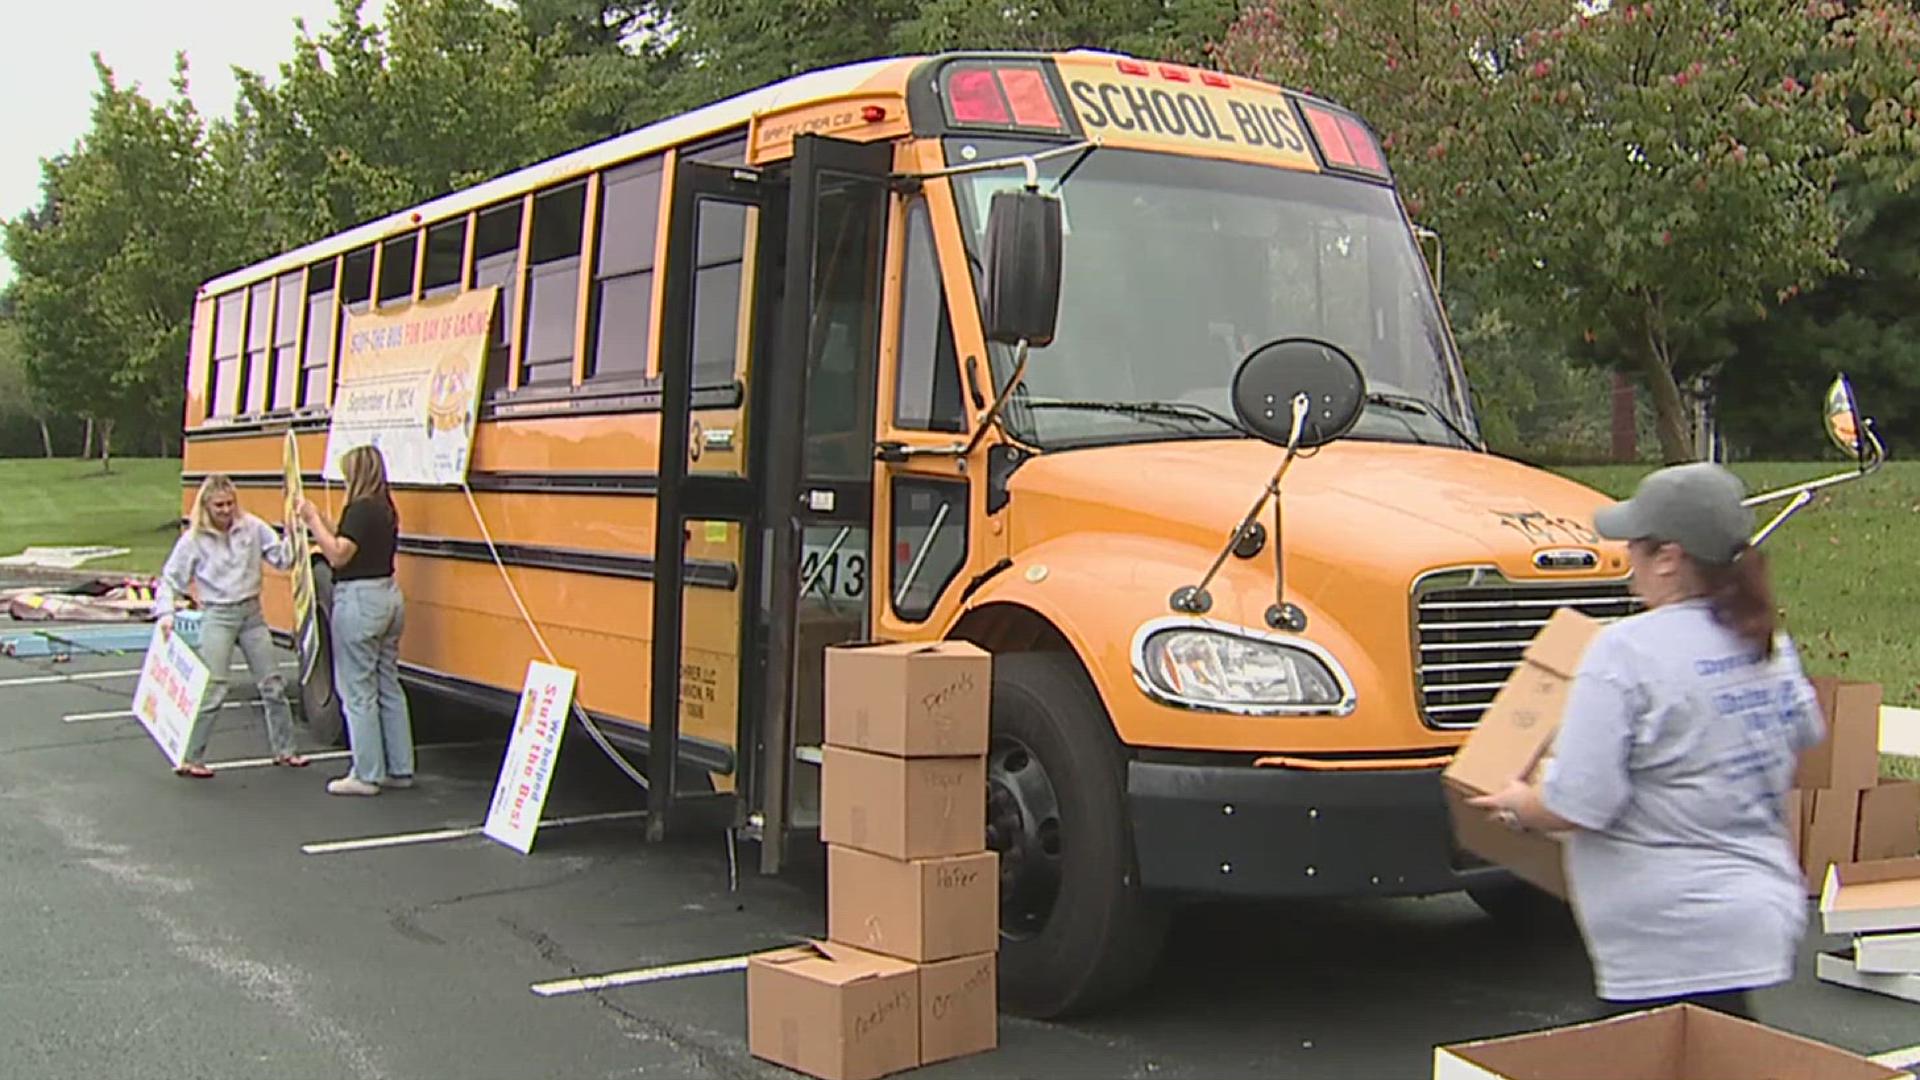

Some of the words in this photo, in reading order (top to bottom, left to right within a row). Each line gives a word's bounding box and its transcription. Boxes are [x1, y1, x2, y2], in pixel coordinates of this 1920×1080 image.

[1071, 80, 1236, 143] SCHOOL
[1228, 100, 1304, 152] BUS
[405, 321, 421, 345] FOR
[422, 318, 439, 344] DAY
[440, 315, 454, 341] OF
[347, 391, 385, 414] September
[691, 420, 701, 463] 3
[801, 551, 865, 598] 413
[536, 683, 557, 739] Stuff
[548, 719, 560, 743] We
[524, 742, 542, 778] the
[532, 745, 553, 803] helped
[510, 783, 531, 831] Bus!
